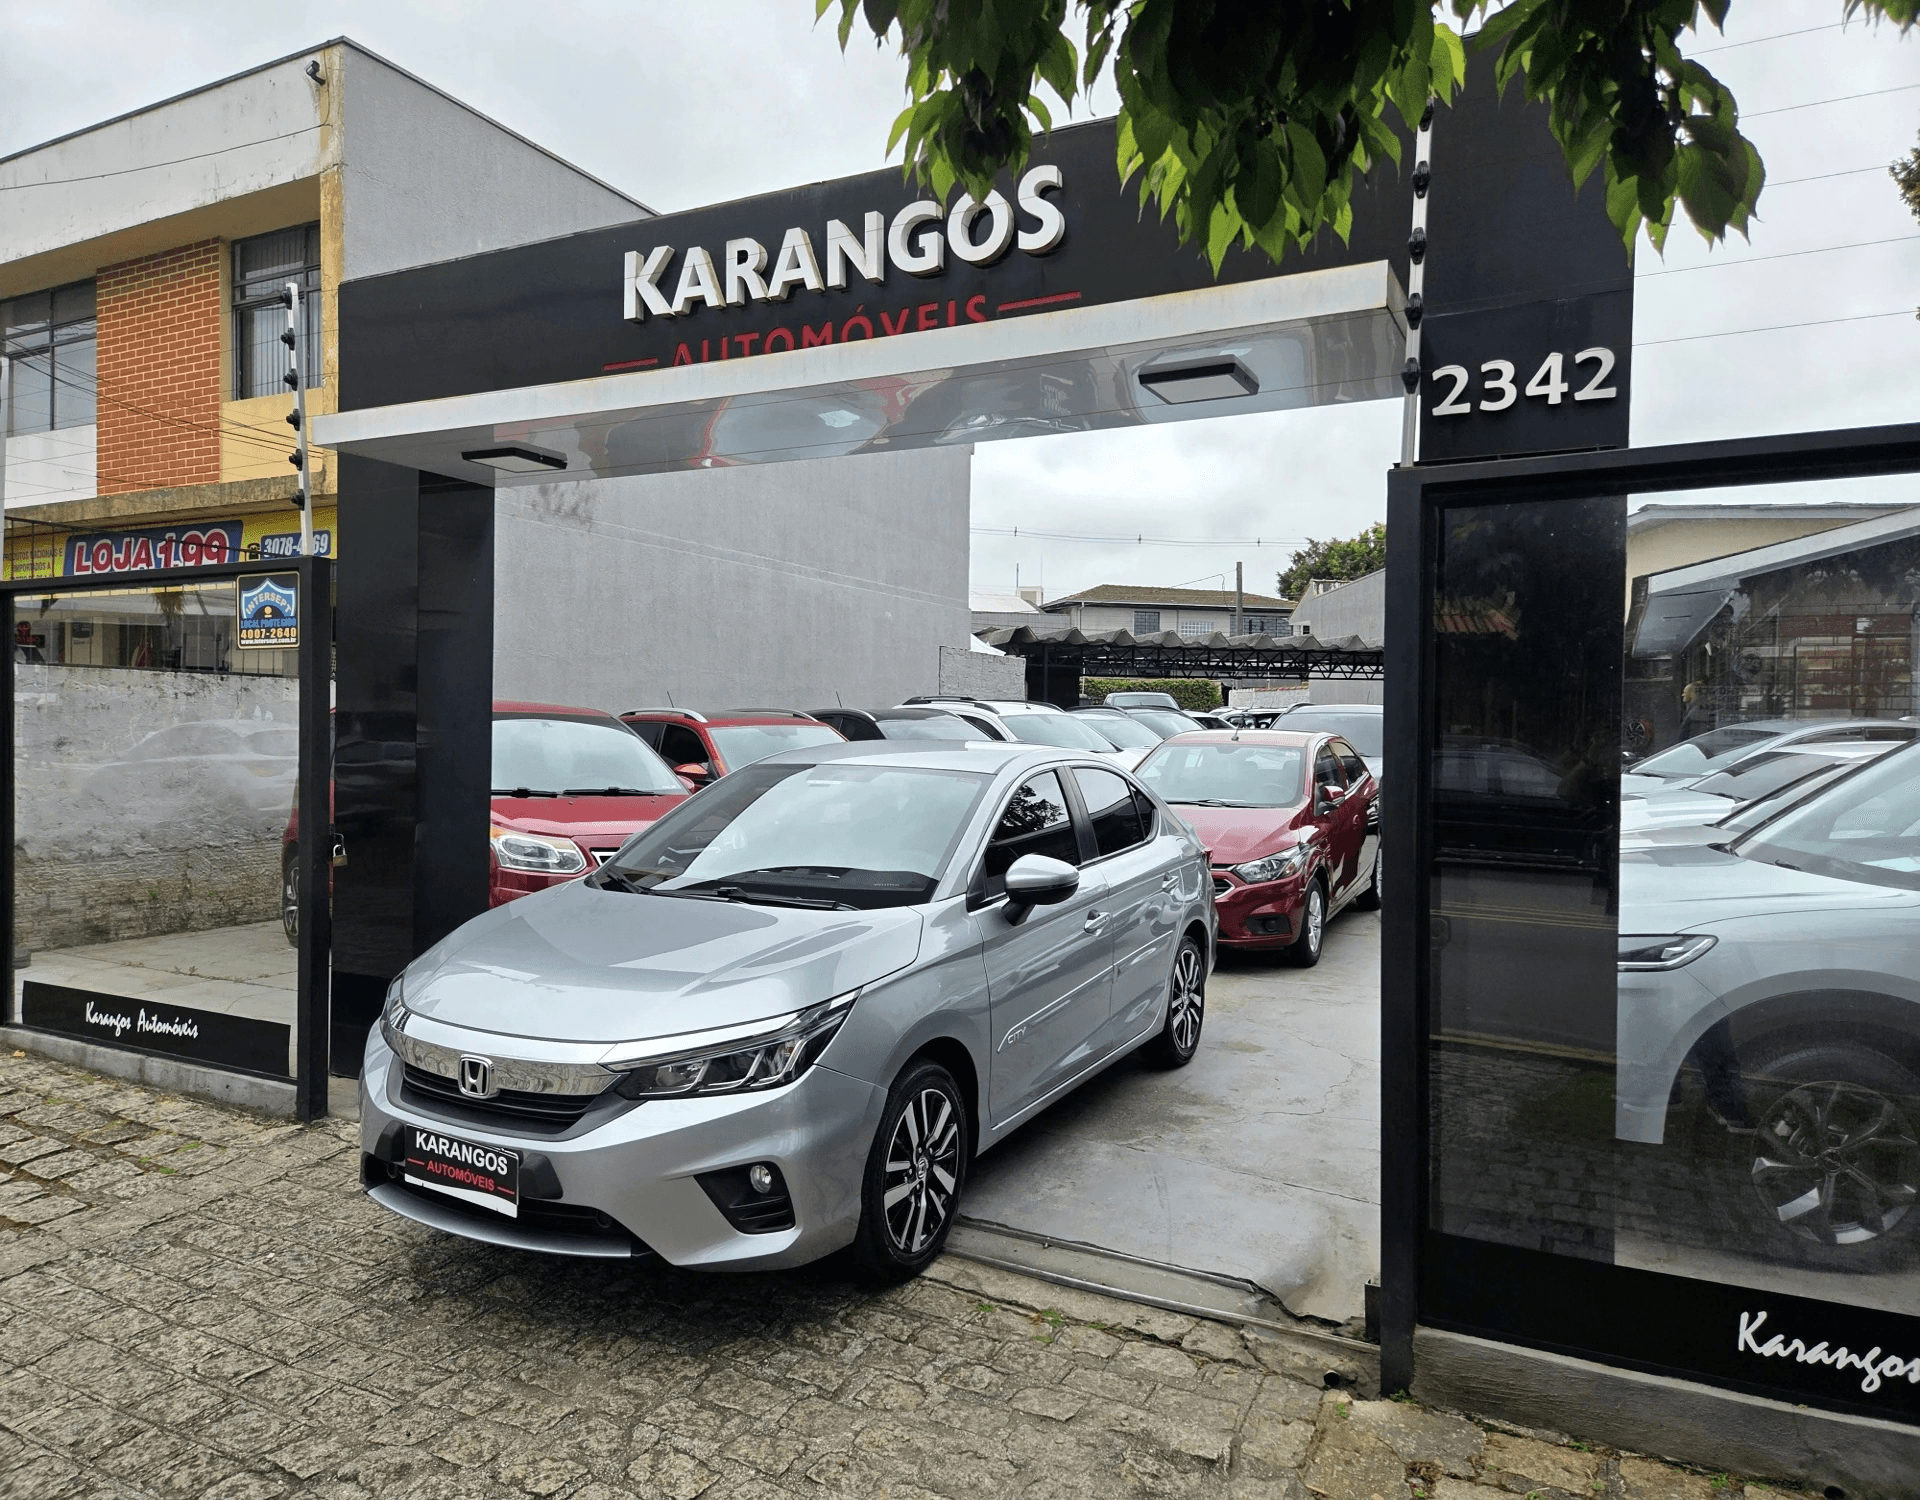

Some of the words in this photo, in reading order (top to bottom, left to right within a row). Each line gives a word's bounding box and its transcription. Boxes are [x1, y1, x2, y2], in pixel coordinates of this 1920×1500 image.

[624, 164, 1065, 323] KARANGOS
[1432, 347, 1617, 416] 2342
[74, 538, 155, 575] LOJA
[264, 533, 329, 557] 3078-469
[245, 592, 292, 615] INTERSEPT
[240, 628, 297, 640] 4007-2640
[85, 1001, 131, 1037] Karangos
[415, 1131, 508, 1175] KARANGOS
[426, 1160, 495, 1191] AUTOMÓVEIS
[1738, 1311, 1920, 1393] Karangos
